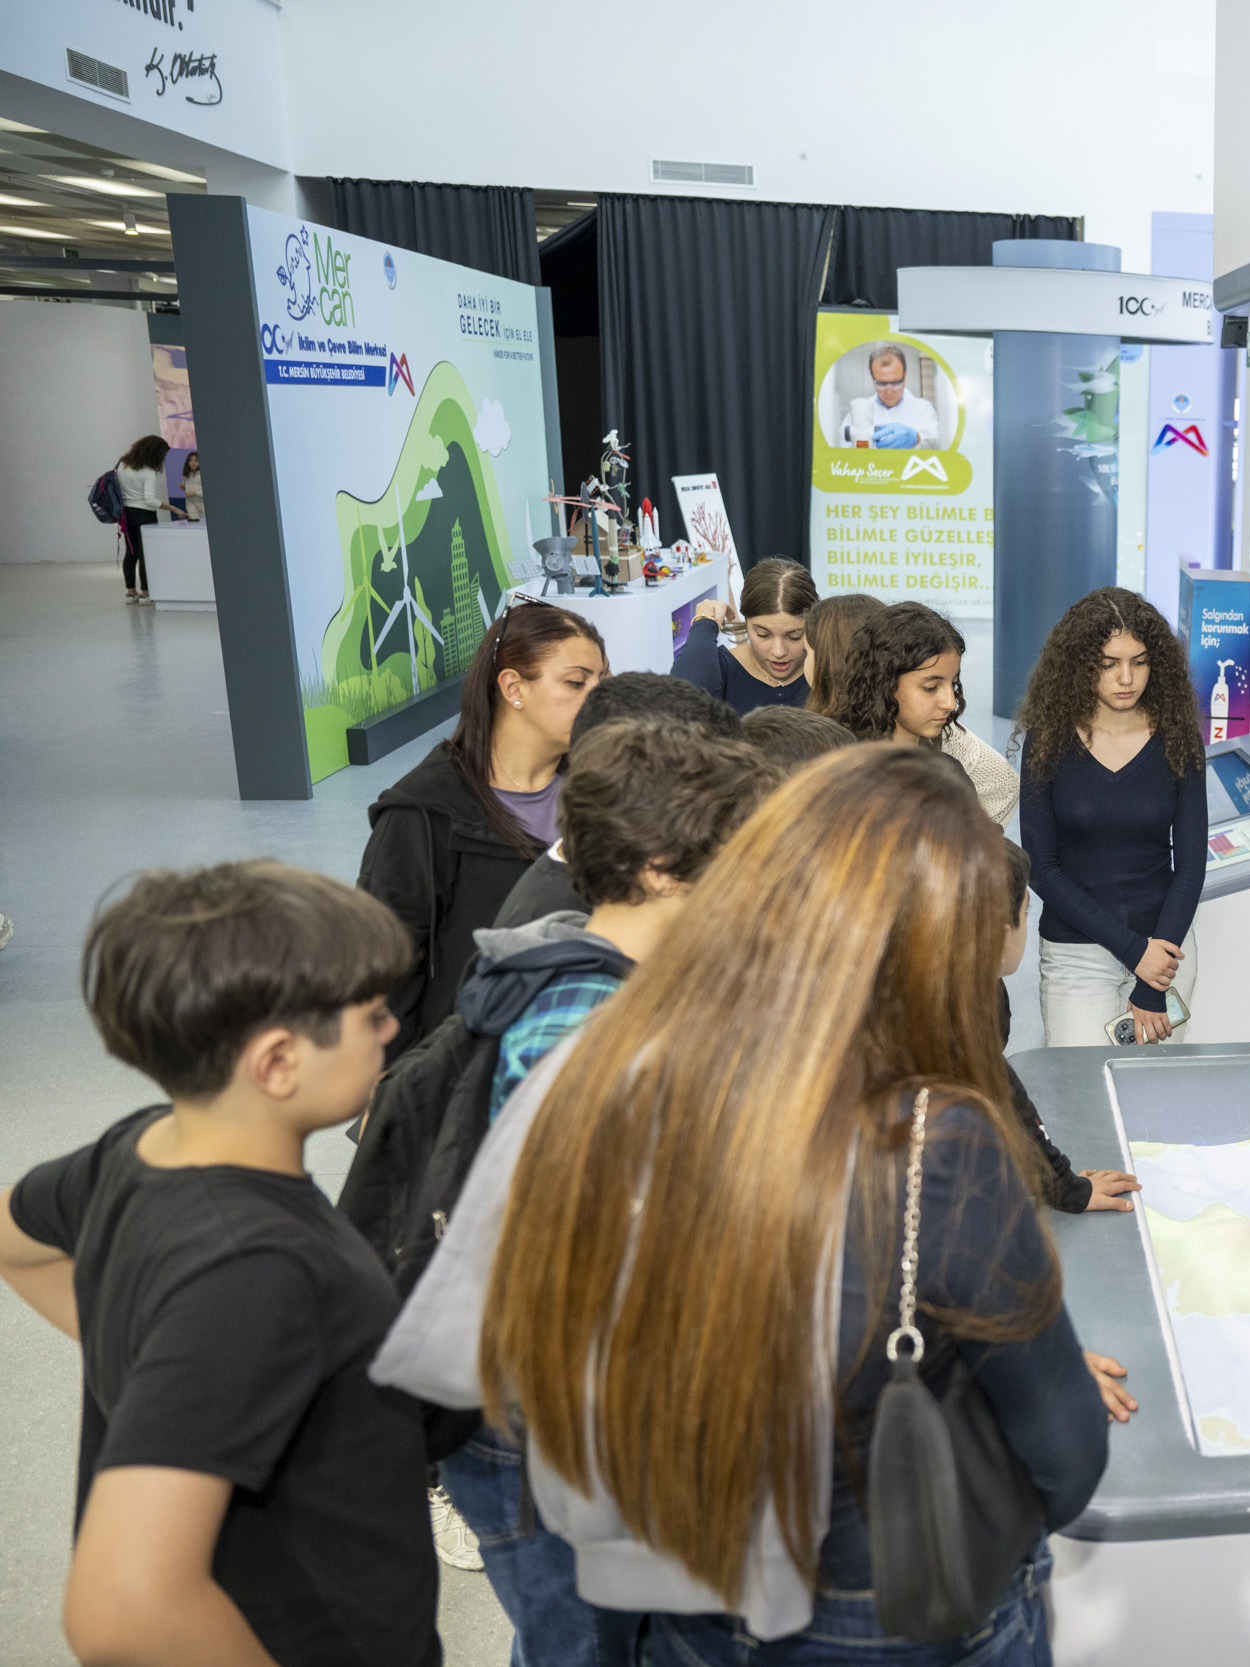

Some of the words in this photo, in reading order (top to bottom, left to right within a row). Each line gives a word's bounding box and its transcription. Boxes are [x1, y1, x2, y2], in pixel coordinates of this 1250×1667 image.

[313, 232, 351, 288] Mer
[320, 286, 355, 327] can
[458, 293, 477, 311] DAHA
[478, 294, 488, 312] İYİ
[490, 297, 501, 315] BİR
[460, 314, 501, 338] GELECEK
[503, 324, 515, 342] İÇİN
[516, 328, 522, 341] EL
[523, 330, 533, 342] ELE
[298, 331, 316, 351] İklim
[317, 340, 326, 352] ve
[327, 338, 346, 357] Çevre
[347, 340, 363, 355] Bilim
[364, 341, 387, 357] Merkezi
[278, 366, 288, 377] T.C.
[289, 363, 309, 378] MERSİN
[310, 364, 341, 382] BÜYÜKŞEHİR
[341, 366, 366, 380] BELEDİYESİ
[830, 460, 864, 484] Vahap
[866, 462, 894, 478] Seçer
[826, 504, 862, 518] HER
[868, 505, 900, 523] ŞEY
[906, 502, 977, 521] BİLİMLE
[984, 508, 994, 521] B
[826, 524, 898, 542] BİLİMLE
[905, 525, 994, 549] GÜZELLEŞ
[827, 547, 899, 565] BİLİMLE
[905, 548, 982, 571] İYİLEŞİR,
[828, 570, 899, 588] BİLİMLE
[1202, 608, 1244, 623] Salgından
[1201, 621, 1249, 635] korunmak
[1201, 634, 1221, 649] için;
